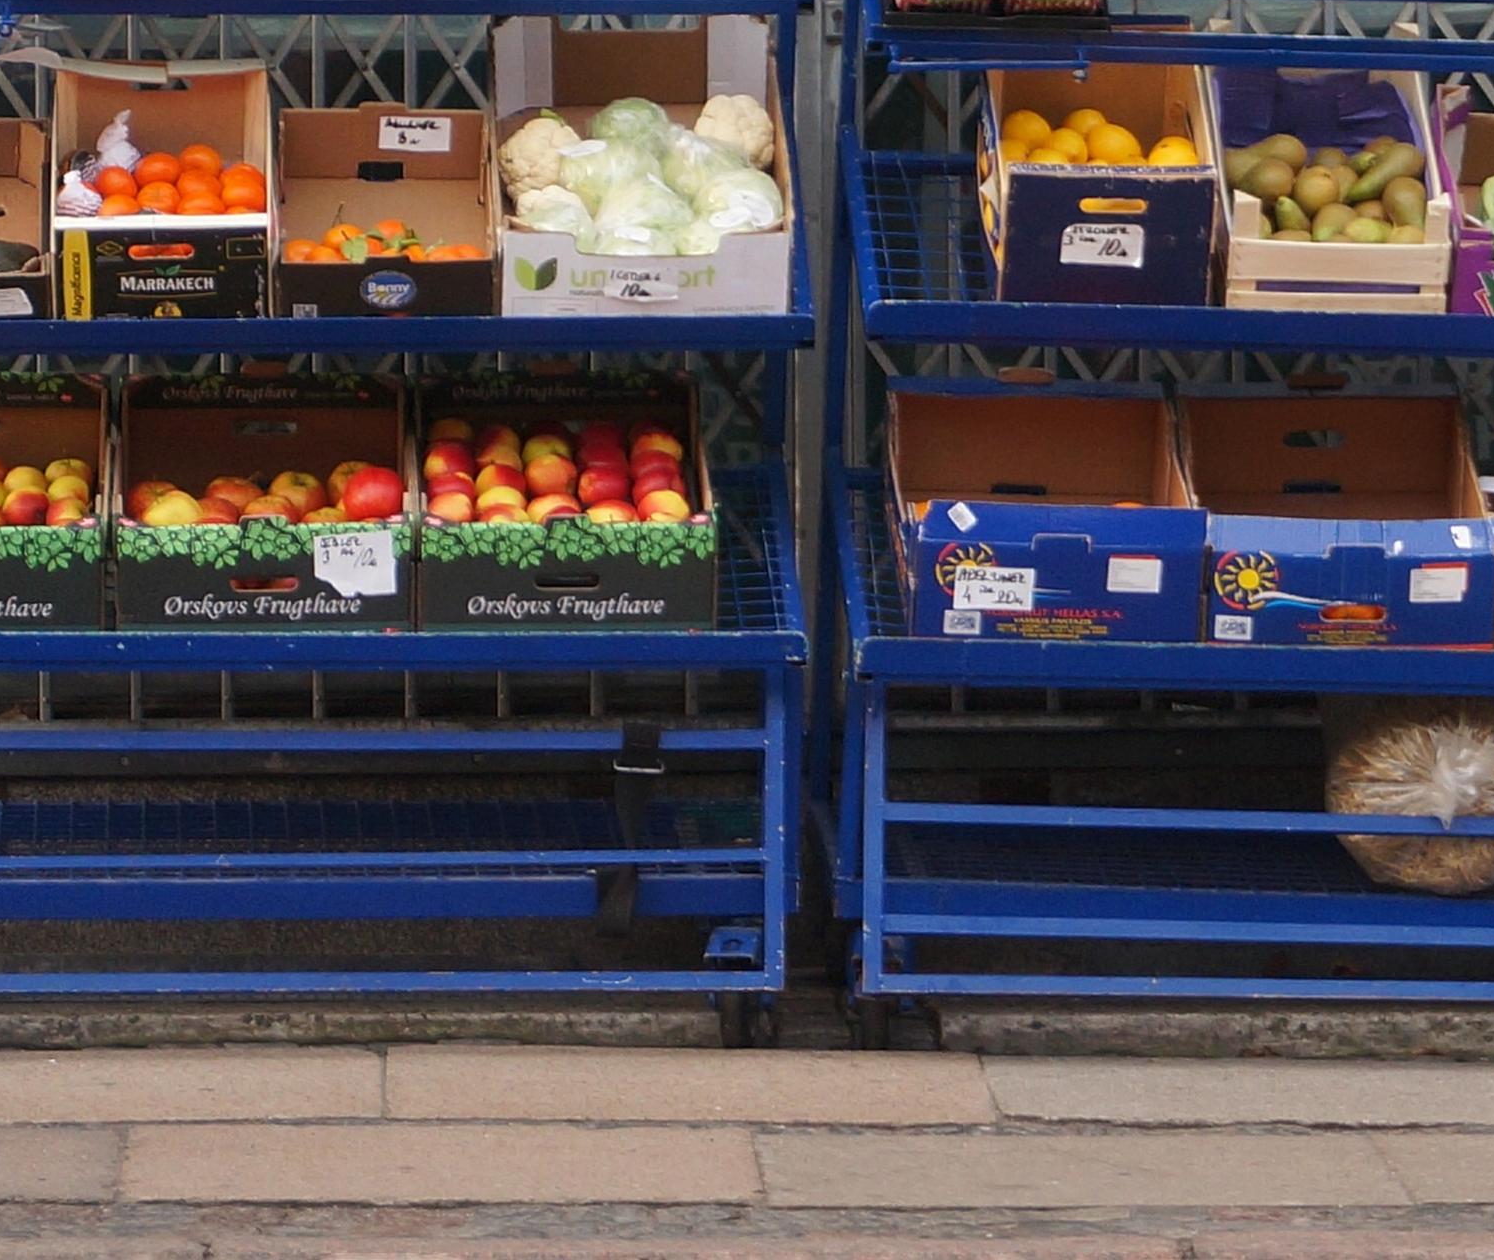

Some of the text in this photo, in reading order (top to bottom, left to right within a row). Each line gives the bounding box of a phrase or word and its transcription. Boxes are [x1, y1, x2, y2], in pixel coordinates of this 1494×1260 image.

[120, 275, 215, 291] MARRAKECH
[164, 592, 362, 623] Ørskovs Frugthave
[467, 593, 665, 622] Ørskovs Frugthave
